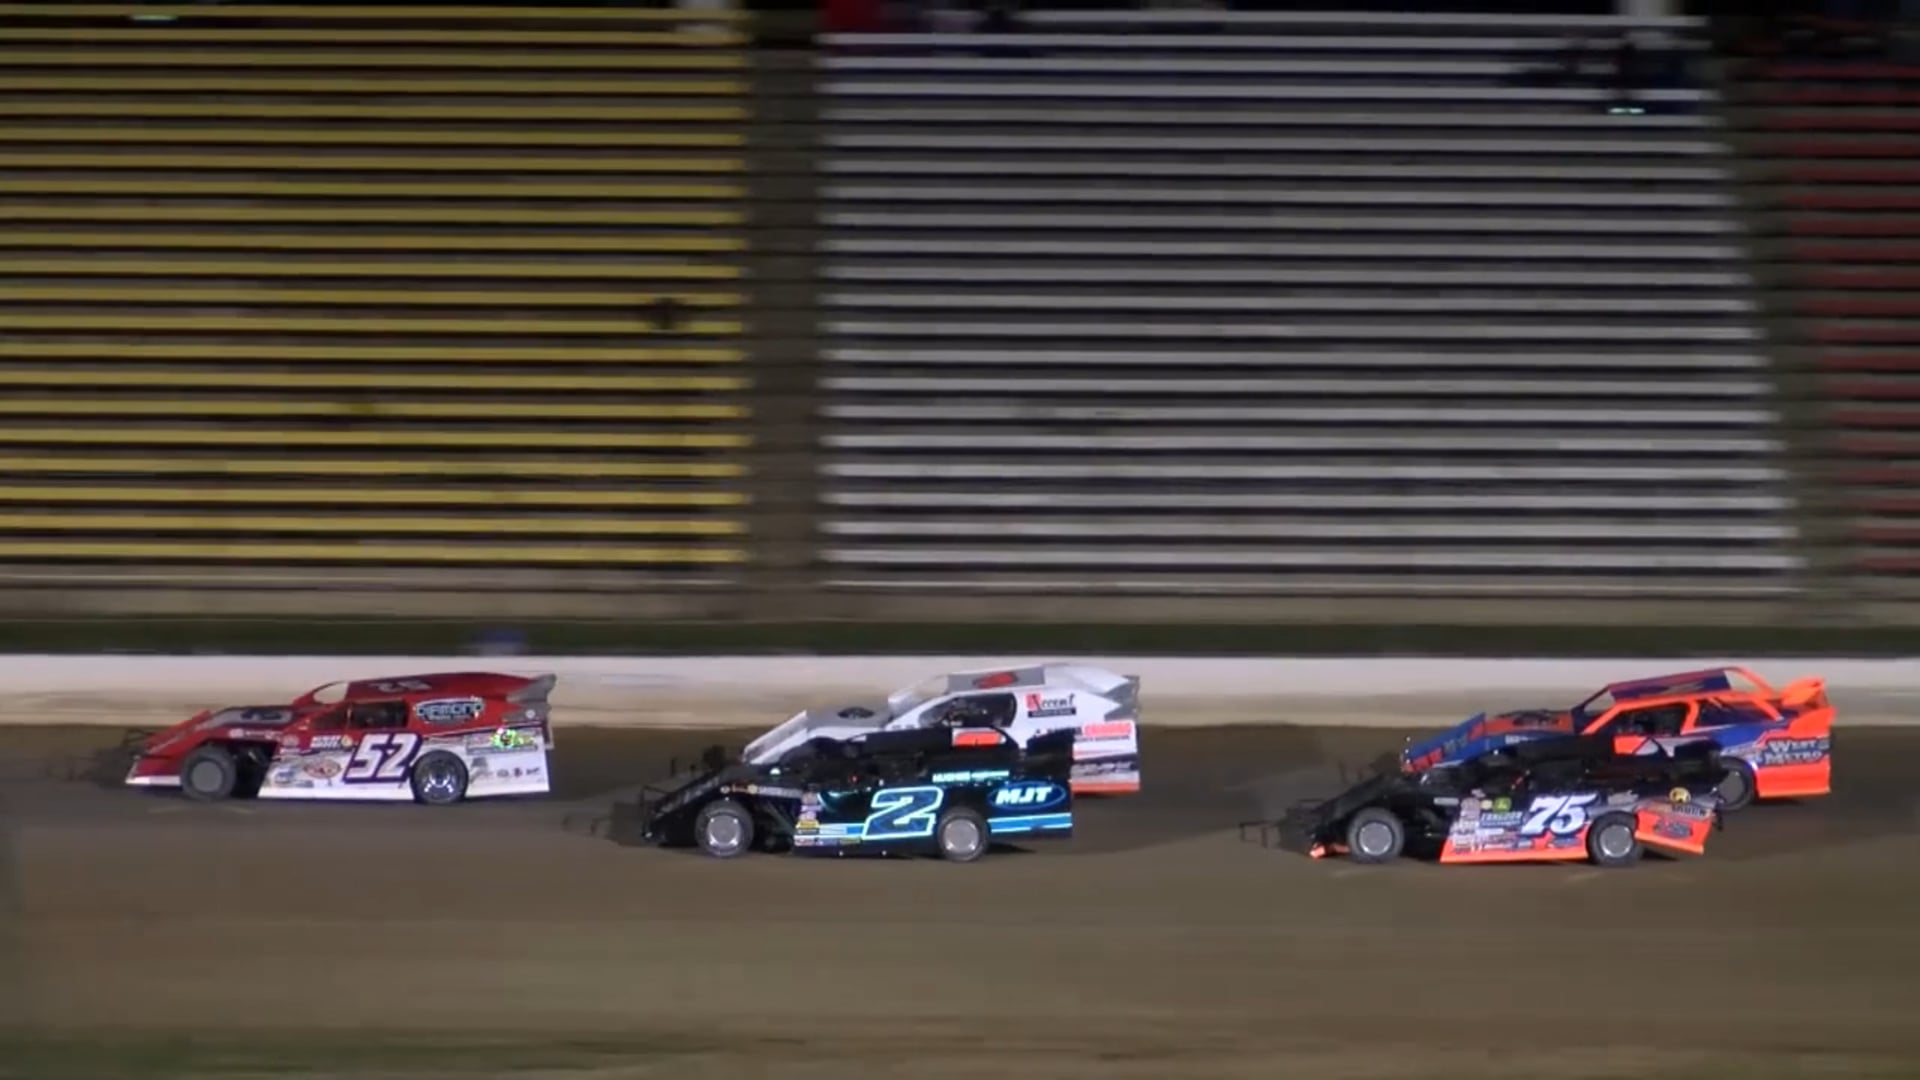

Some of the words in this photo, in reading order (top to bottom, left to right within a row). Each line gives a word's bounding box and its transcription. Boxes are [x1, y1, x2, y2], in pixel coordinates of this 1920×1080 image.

[343, 732, 420, 781] 52
[861, 786, 943, 840] 2
[995, 786, 1053, 805] MJT
[1521, 793, 1599, 835] 75
